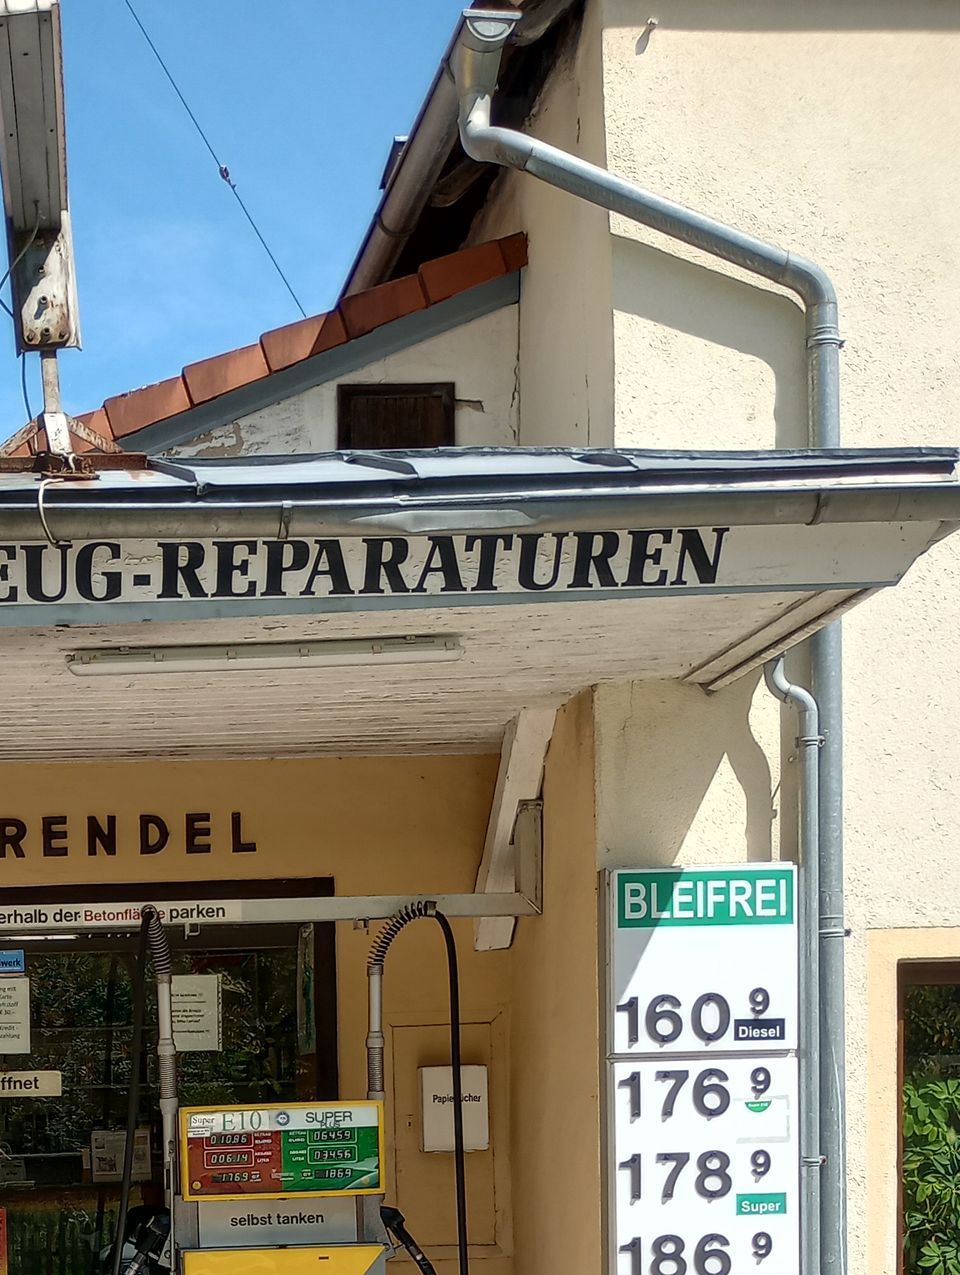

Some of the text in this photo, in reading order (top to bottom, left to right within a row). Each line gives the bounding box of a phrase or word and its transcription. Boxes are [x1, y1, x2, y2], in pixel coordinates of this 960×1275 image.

[623, 879, 787, 920] BLEIFREI
[53, 908, 80, 923] der
[84, 906, 166, 923] Betonfläe
[169, 904, 226, 922] parken
[616, 987, 771, 1045] 160 9
[738, 1025, 781, 1039] Diesel
[617, 1066, 772, 1119] 176 9
[192, 1116, 215, 1126] Super
[222, 1111, 262, 1132] E10
[304, 1110, 352, 1123] SUPER
[210, 1154, 248, 1164] 006.14
[618, 1149, 772, 1200] 178 9
[741, 1201, 781, 1215] Super
[230, 1211, 324, 1227] selbst tanken
[751, 1231, 773, 1259] 9
